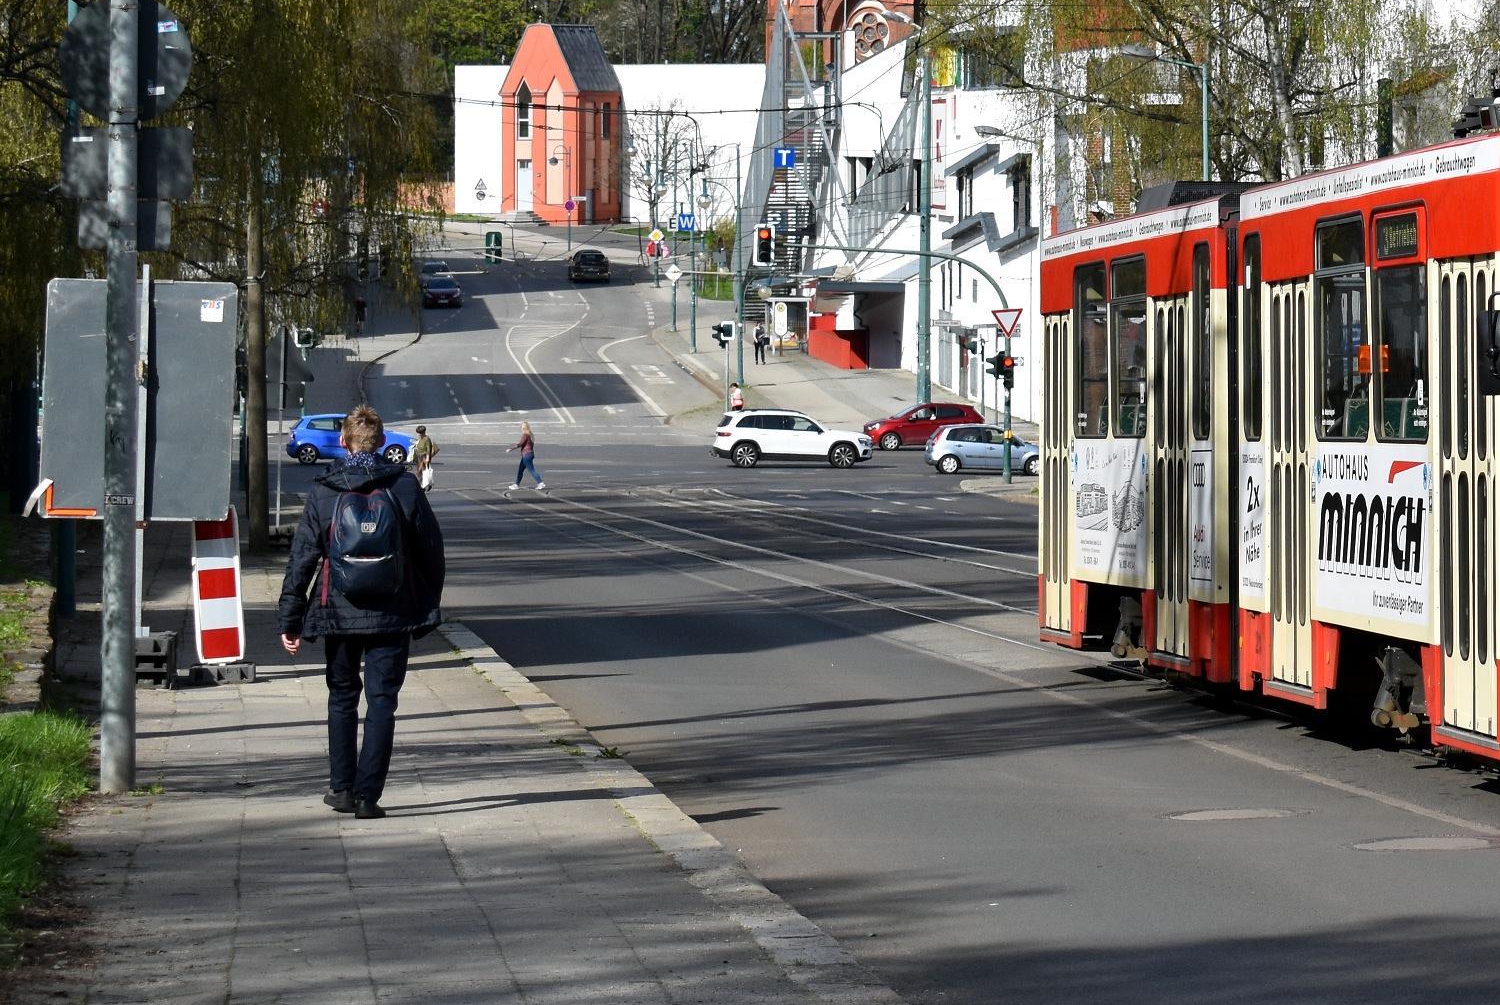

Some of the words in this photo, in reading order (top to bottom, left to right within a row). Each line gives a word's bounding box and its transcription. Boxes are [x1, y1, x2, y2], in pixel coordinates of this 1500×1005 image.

[778, 150, 791, 165] T
[1371, 157, 1426, 186] www.autohaus-minnich.de
[1435, 151, 1476, 174] Gebrauchtwagen
[680, 216, 695, 229] W
[1322, 454, 1369, 482] AUTOHAUS
[111, 495, 134, 505] CREW
[1246, 475, 1260, 514] 2x
[1193, 524, 1206, 543] Audi
[1243, 524, 1249, 544] in
[1250, 519, 1263, 539] Ihrer
[1193, 550, 1211, 570] Service
[1245, 542, 1261, 565] Nähe
[1379, 592, 1407, 616] zuverlässiger
[1407, 595, 1424, 615] Partner
